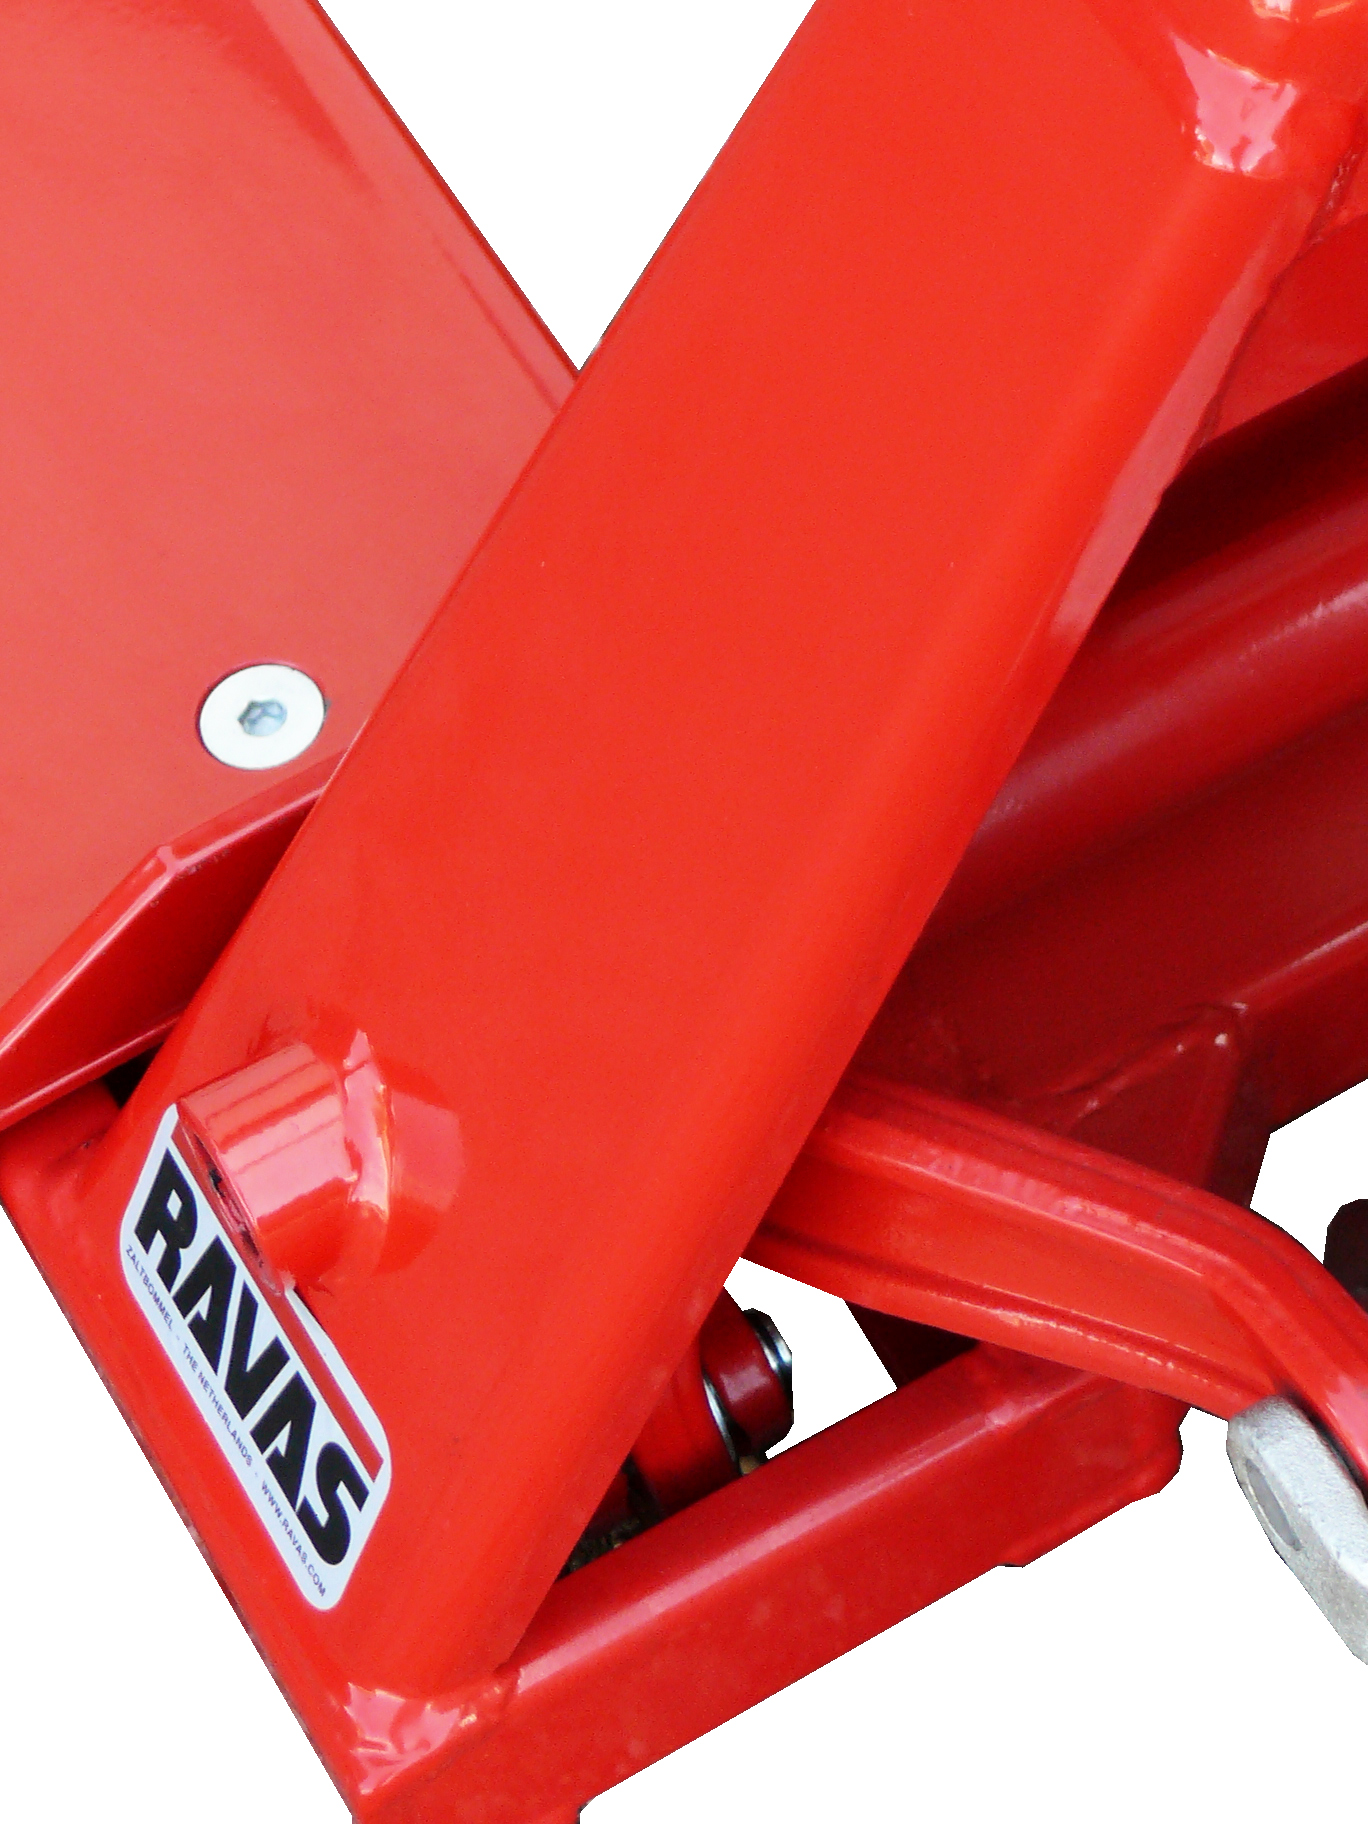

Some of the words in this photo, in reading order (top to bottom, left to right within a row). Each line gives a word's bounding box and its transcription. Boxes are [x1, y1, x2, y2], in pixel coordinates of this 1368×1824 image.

[125, 1244, 174, 1332] ZALTBOMMEL
[181, 1342, 199, 1371] THE
[197, 1370, 253, 1468] NETHERLANDS
[261, 1479, 327, 1598] WWW.RAVAS.COM
[134, 1147, 370, 1566] RAVAS
